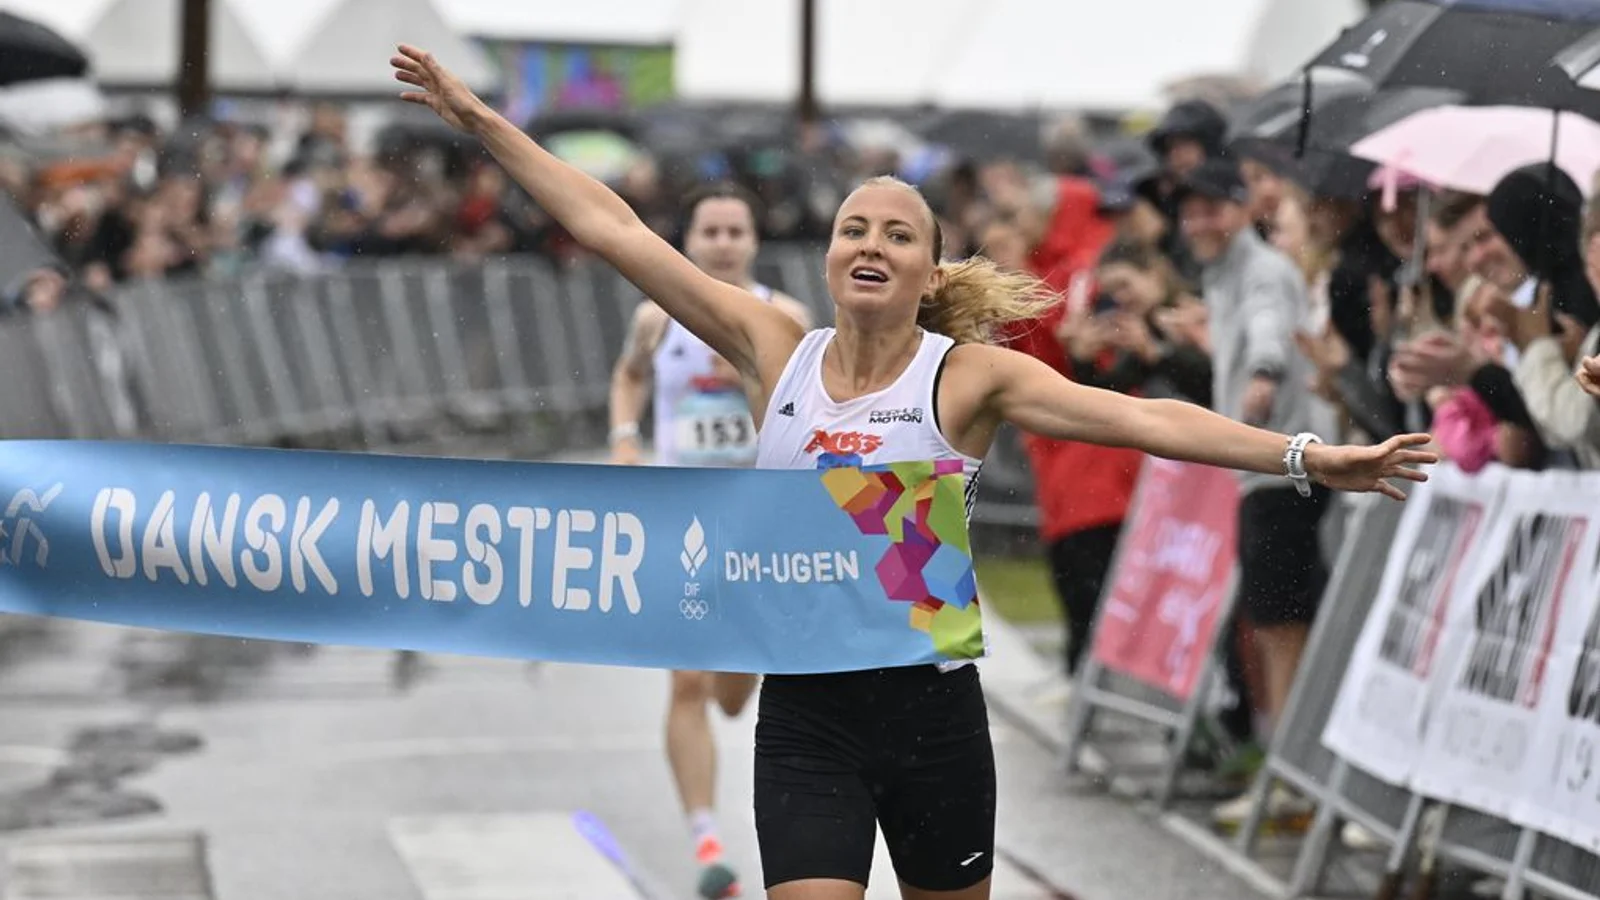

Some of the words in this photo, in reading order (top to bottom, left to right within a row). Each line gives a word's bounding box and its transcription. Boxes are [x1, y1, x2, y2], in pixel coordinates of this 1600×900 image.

[695, 417, 748, 448] 153
[869, 414, 923, 424] MOTION
[90, 487, 339, 596] DANSK
[356, 498, 646, 615] MESTER
[725, 549, 860, 583] DM-UGEN
[684, 582, 700, 597] DIF
